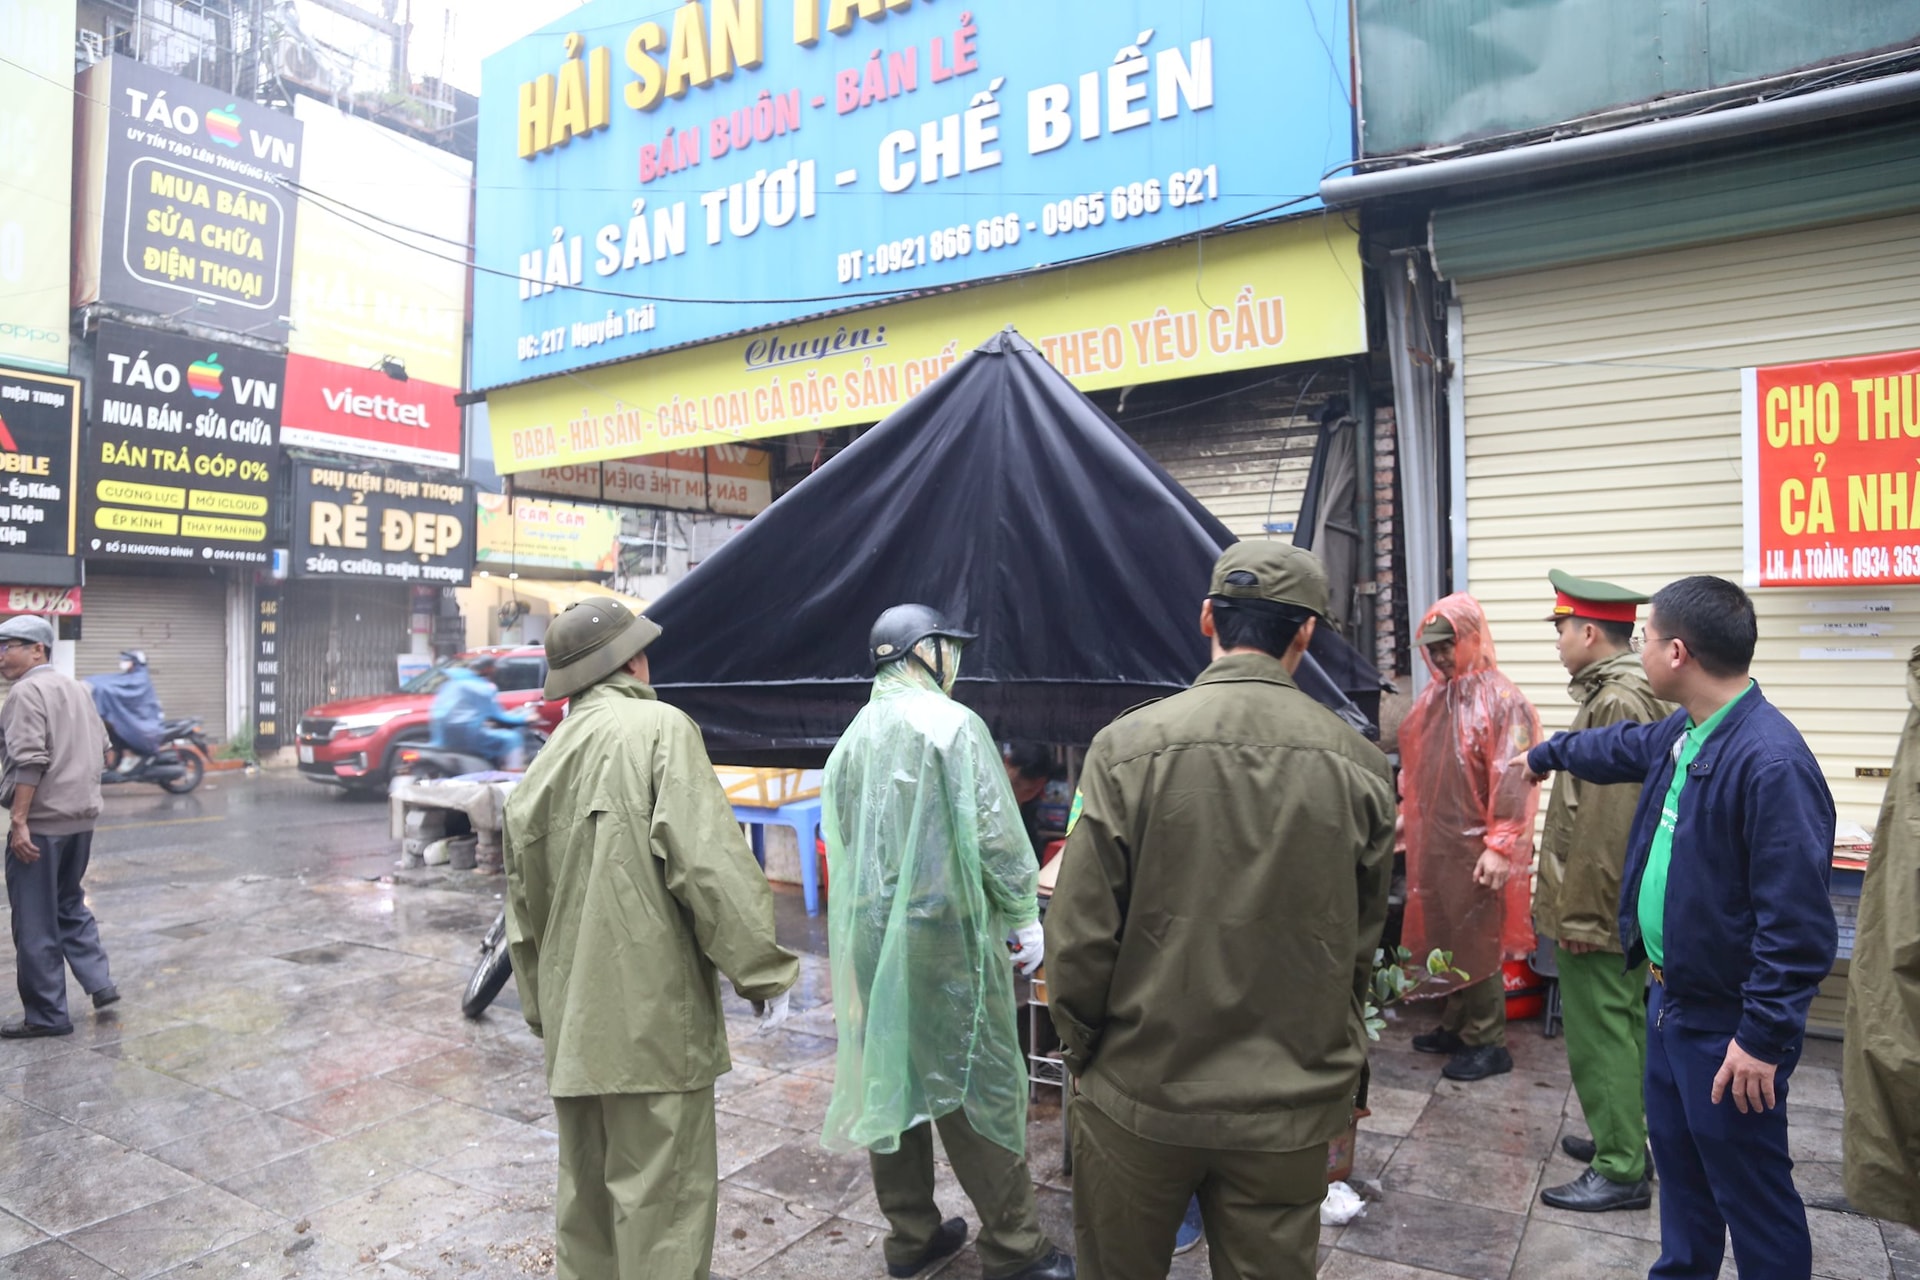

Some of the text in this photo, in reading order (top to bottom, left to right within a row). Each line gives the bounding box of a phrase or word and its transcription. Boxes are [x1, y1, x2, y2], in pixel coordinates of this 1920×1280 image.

[518, 31, 612, 160] HẢI
[639, 127, 701, 184] BÁN
[709, 90, 801, 159] BUÔN
[836, 48, 917, 115] BÁN
[930, 11, 978, 84] LẺ
[126, 87, 295, 168] TÁO VN
[127, 128, 146, 142] UY
[147, 133, 166, 149] TÍN
[168, 141, 192, 157] TẠO
[519, 226, 583, 301] HẢI
[595, 198, 687, 277] SẢN
[700, 159, 815, 245] TƯƠI
[878, 76, 1005, 193] CHẾ
[1027, 28, 1214, 155] BIẾN
[151, 170, 267, 225] MUA BÁN
[930, 223, 971, 262] 866
[976, 212, 1019, 252] 666
[1042, 191, 1105, 236] 0965
[1111, 178, 1161, 220] 686
[1168, 164, 1217, 207] 621
[146, 205, 263, 261] SỬA CHỮA
[143, 246, 262, 300] ĐIỆN THOẠI
[0, 323, 60, 344] oppo
[541, 326, 566, 356] 217
[571, 309, 624, 348] Nguyễn
[626, 303, 655, 334] Trãi
[744, 325, 886, 367] Chuyên:
[107, 350, 277, 410] TÁO VN
[512, 425, 557, 460] BABA
[570, 408, 599, 451] HẢI
[604, 402, 642, 446] SẢN
[658, 396, 697, 437] CÁC
[702, 391, 749, 434] LOẠI
[755, 377, 785, 422] CÁ
[790, 371, 837, 423] ĐẶC
[844, 356, 897, 409] SẢN
[1041, 327, 1123, 377] THEO
[1130, 308, 1198, 365] YÊU
[1208, 286, 1284, 353] CẦU
[102, 399, 143, 428] MUA
[147, 403, 183, 433] BÁN
[195, 408, 227, 440] SỬA
[230, 417, 272, 446] CHỮA
[1765, 381, 1840, 449] CHO
[101, 440, 269, 481] BÁN TRẢ GÓP 0%
[218, 499, 259, 511] ICLOUD
[311, 468, 344, 491] PHỤ
[347, 471, 381, 494] KIỆN
[422, 482, 464, 505] THOẠI
[1779, 452, 1836, 536] CẢ
[130, 514, 163, 529] KÍNH
[310, 492, 463, 563] RẺ ĐẸP
[556, 512, 585, 526] CAM
[306, 552, 339, 573] SỬA
[1766, 549, 1788, 580] LH.
[1792, 549, 1802, 579] A
[1805, 541, 1849, 579] TOÀN:
[1852, 546, 1889, 578] 0934
[261, 621, 276, 635] PIN
[262, 641, 275, 655] TAI
[258, 661, 279, 675] NGHE
[259, 721, 276, 735] SIM
